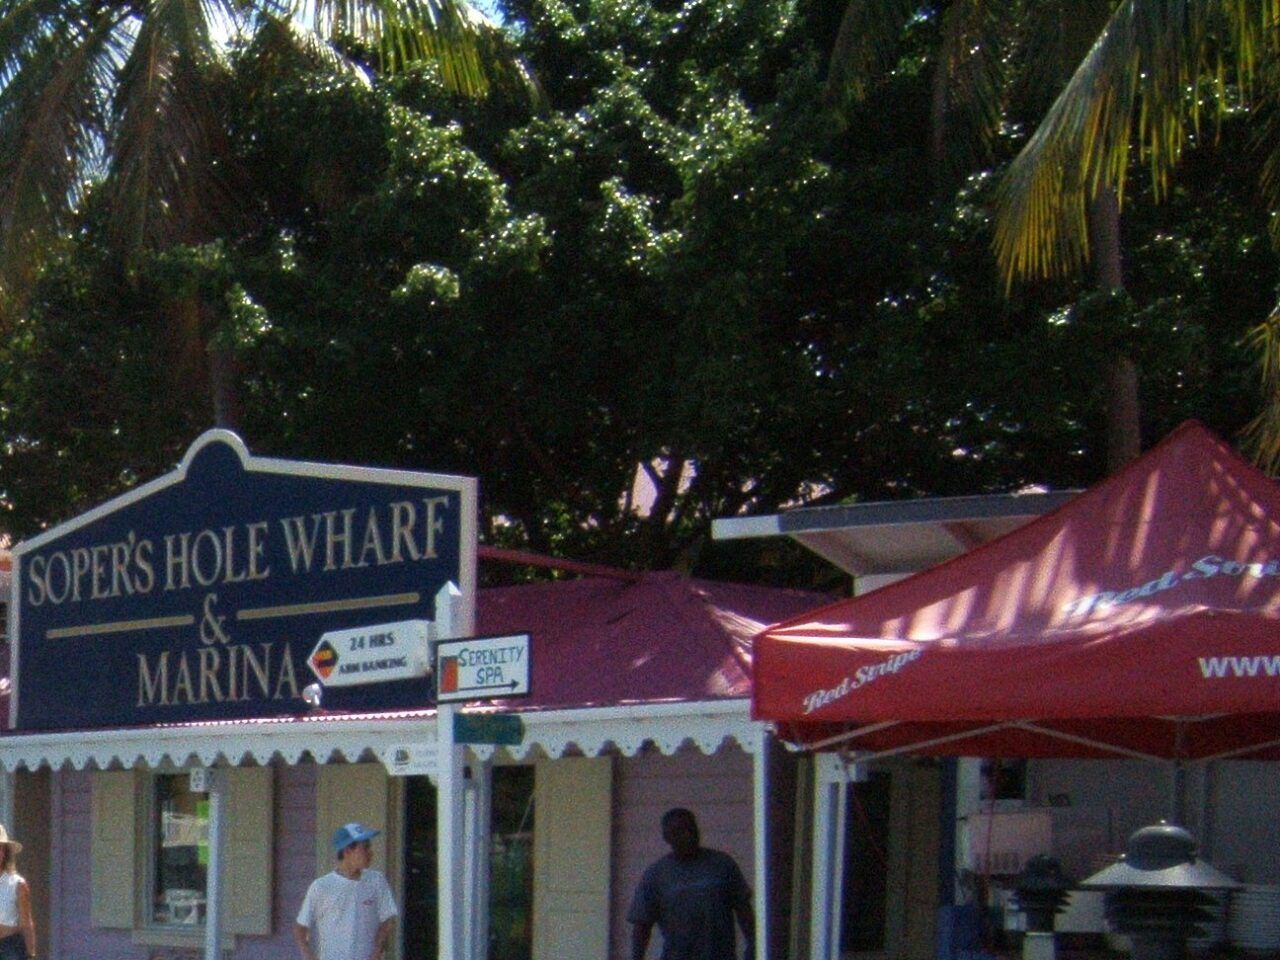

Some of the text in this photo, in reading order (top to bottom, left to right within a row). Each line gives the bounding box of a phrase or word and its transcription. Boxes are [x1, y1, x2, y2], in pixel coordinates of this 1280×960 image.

[28, 496, 449, 606] SOPER'S HOLE WHARF
[200, 593, 231, 645] &
[350, 632, 396, 651] 24 HRS
[136, 641, 301, 708] MARINA
[458, 646, 524, 667] SERENITY
[476, 666, 504, 684] SPA
[803, 646, 924, 715] Red Stripe
